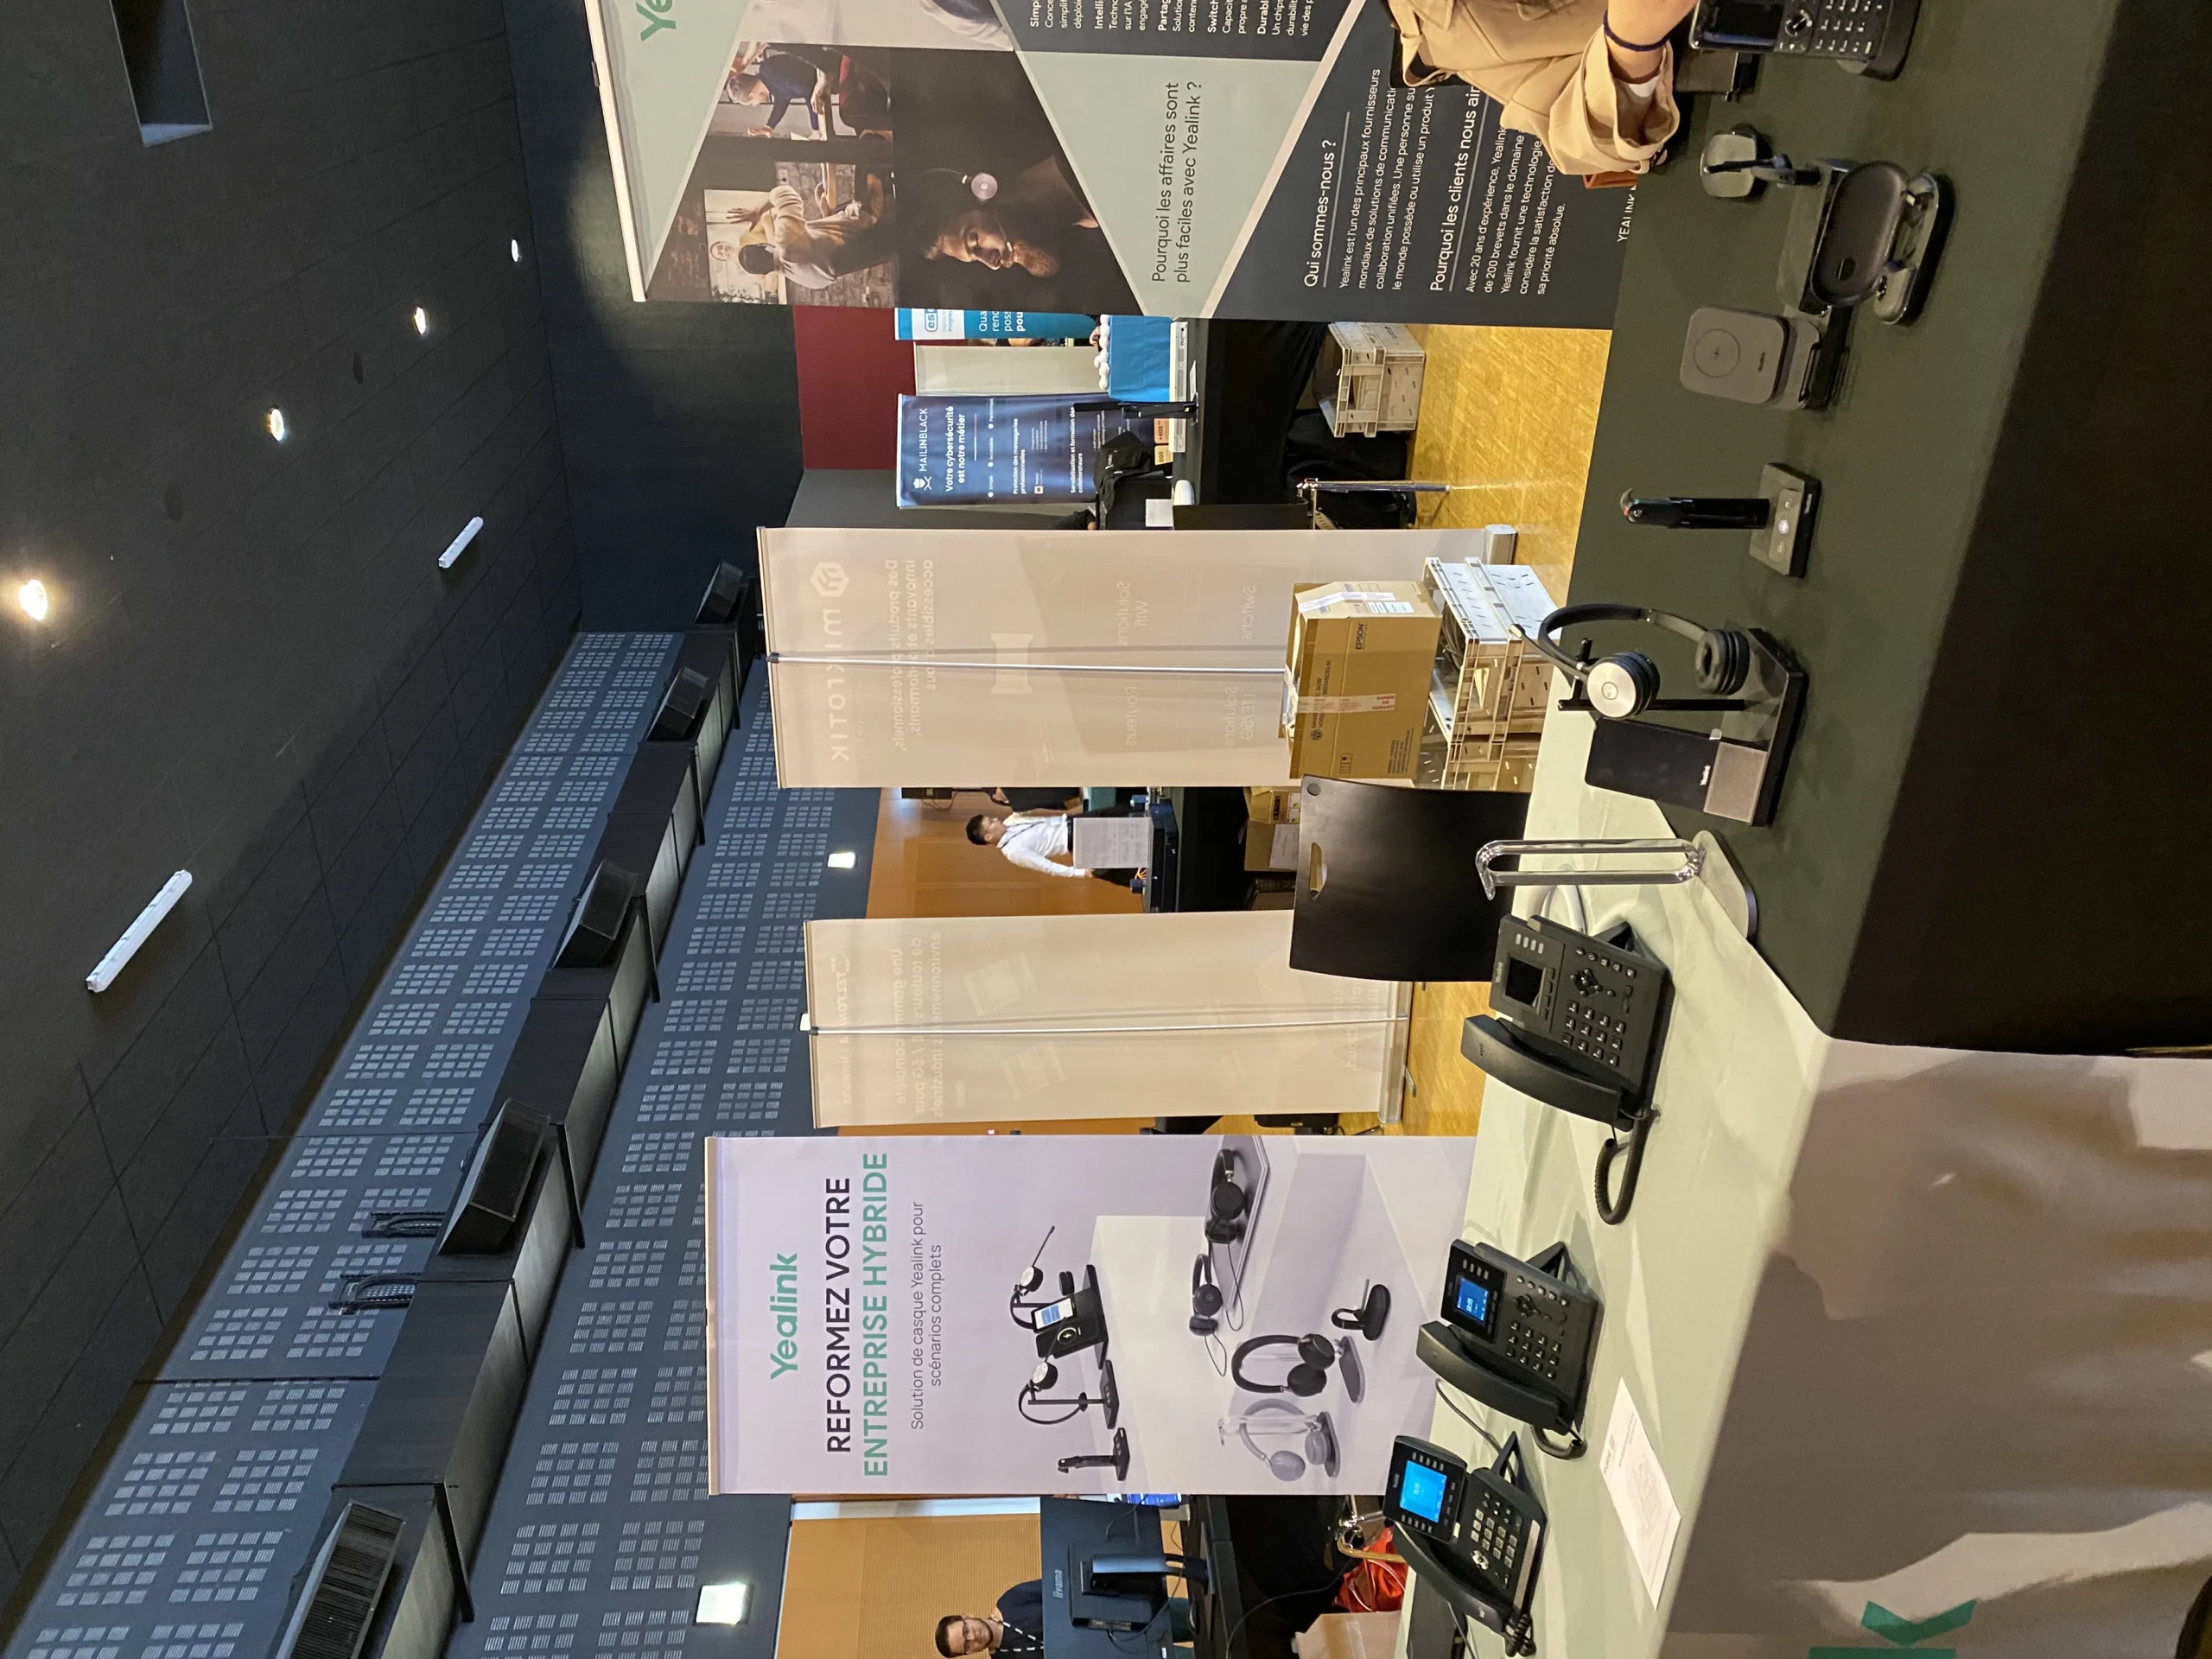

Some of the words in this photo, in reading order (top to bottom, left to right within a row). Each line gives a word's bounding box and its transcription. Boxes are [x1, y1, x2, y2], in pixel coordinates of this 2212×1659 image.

[1095, 0, 1105, 29] Intelli
[1237, 4, 1248, 34] propre
[1272, 22, 1281, 35] Un
[1300, 22, 1309, 36] vie
[1301, 4, 1312, 22] des
[1166, 82, 1179, 119] sont
[1186, 81, 1201, 90] ?
[1361, 68, 1381, 138] fournisseurs
[1182, 95, 1201, 154] Yealink
[1398, 103, 1414, 156] personne
[1419, 93, 1435, 135] produit
[1459, 111, 1477, 149] nous
[1159, 124, 1176, 186] affaires
[1417, 136, 1427, 150] un
[1491, 127, 1507, 164] Yealink
[1508, 135, 1525, 181] domaine
[1183, 157, 1196, 195] avec
[1354, 140, 1370, 196] principaux
[1375, 162, 1386, 176] de
[1393, 156, 1405, 179] Une
[1411, 152, 1425, 184] utilise
[1448, 153, 1469, 202] clients
[1521, 140, 1544, 203] technologie
[1156, 190, 1171, 211] les
[1310, 152, 1335, 258] sommes-nous
[1368, 178, 1383, 226] solutions
[1385, 181, 1402, 225] unifiées.
[1409, 186, 1419, 200] ou
[1478, 166, 1501, 234] d'expérience,
[1504, 183, 1515, 193] le
[1532, 175, 1554, 235] satisfaction
[1175, 200, 1193, 249] faciles
[1350, 197, 1362, 216] des
[1401, 201, 1416, 245] possède
[1442, 205, 1459, 226] les
[1498, 194, 1513, 219] dans
[1517, 205, 1529, 225] une
[1547, 203, 1566, 245] absolue.
[1347, 218, 1358, 236] l'un
[1365, 226, 1376, 240] de
[1476, 235, 1486, 253] ans
[1491, 221, 1507, 258] brevets
[1509, 226, 1524, 259] fournit
[1529, 236, 1540, 245] la
[1152, 216, 1173, 282] Pourquoi
[1345, 238, 1356, 254] est
[1375, 226, 1394, 289] collaboration
[1395, 245, 1408, 280] monde
[1429, 229, 1455, 291] Pourquoi
[1471, 255, 1482, 268] 20
[1539, 246, 1555, 282] priorité
[1173, 252, 1191, 283] plus
[1304, 261, 1320, 287] Qui
[1339, 255, 1353, 289] Yealink
[1358, 241, 1373, 289] mondiaux
[1465, 269, 1478, 292] Avec
[1486, 260, 1498, 278] 200
[1500, 260, 1516, 294] Yealink
[1519, 246, 1538, 295] considère
[1392, 281, 1402, 290] le
[1484, 280, 1494, 293] de
[1536, 283, 1546, 295] sa
[979, 311, 988, 332] Qua
[919, 408, 928, 471] MAILINBLACK
[945, 406, 956, 467] cybersécurité
[957, 414, 965, 442] métier
[1355, 624, 1364, 650] EPSON
[825, 1178, 850, 1281] VOTRE
[862, 1154, 887, 1286] HYBRIDE
[913, 1201, 926, 1235] pour
[911, 1237, 924, 1288] Yealink
[928, 1245, 945, 1313] complets
[769, 1252, 798, 1380] Yealink
[913, 1291, 927, 1345] casque
[825, 1287, 851, 1452] REFORMEZ
[911, 1348, 924, 1367] de
[928, 1316, 942, 1387] scénarios
[862, 1295, 888, 1477] ENTREPRISE
[911, 1370, 924, 1430] Solution
